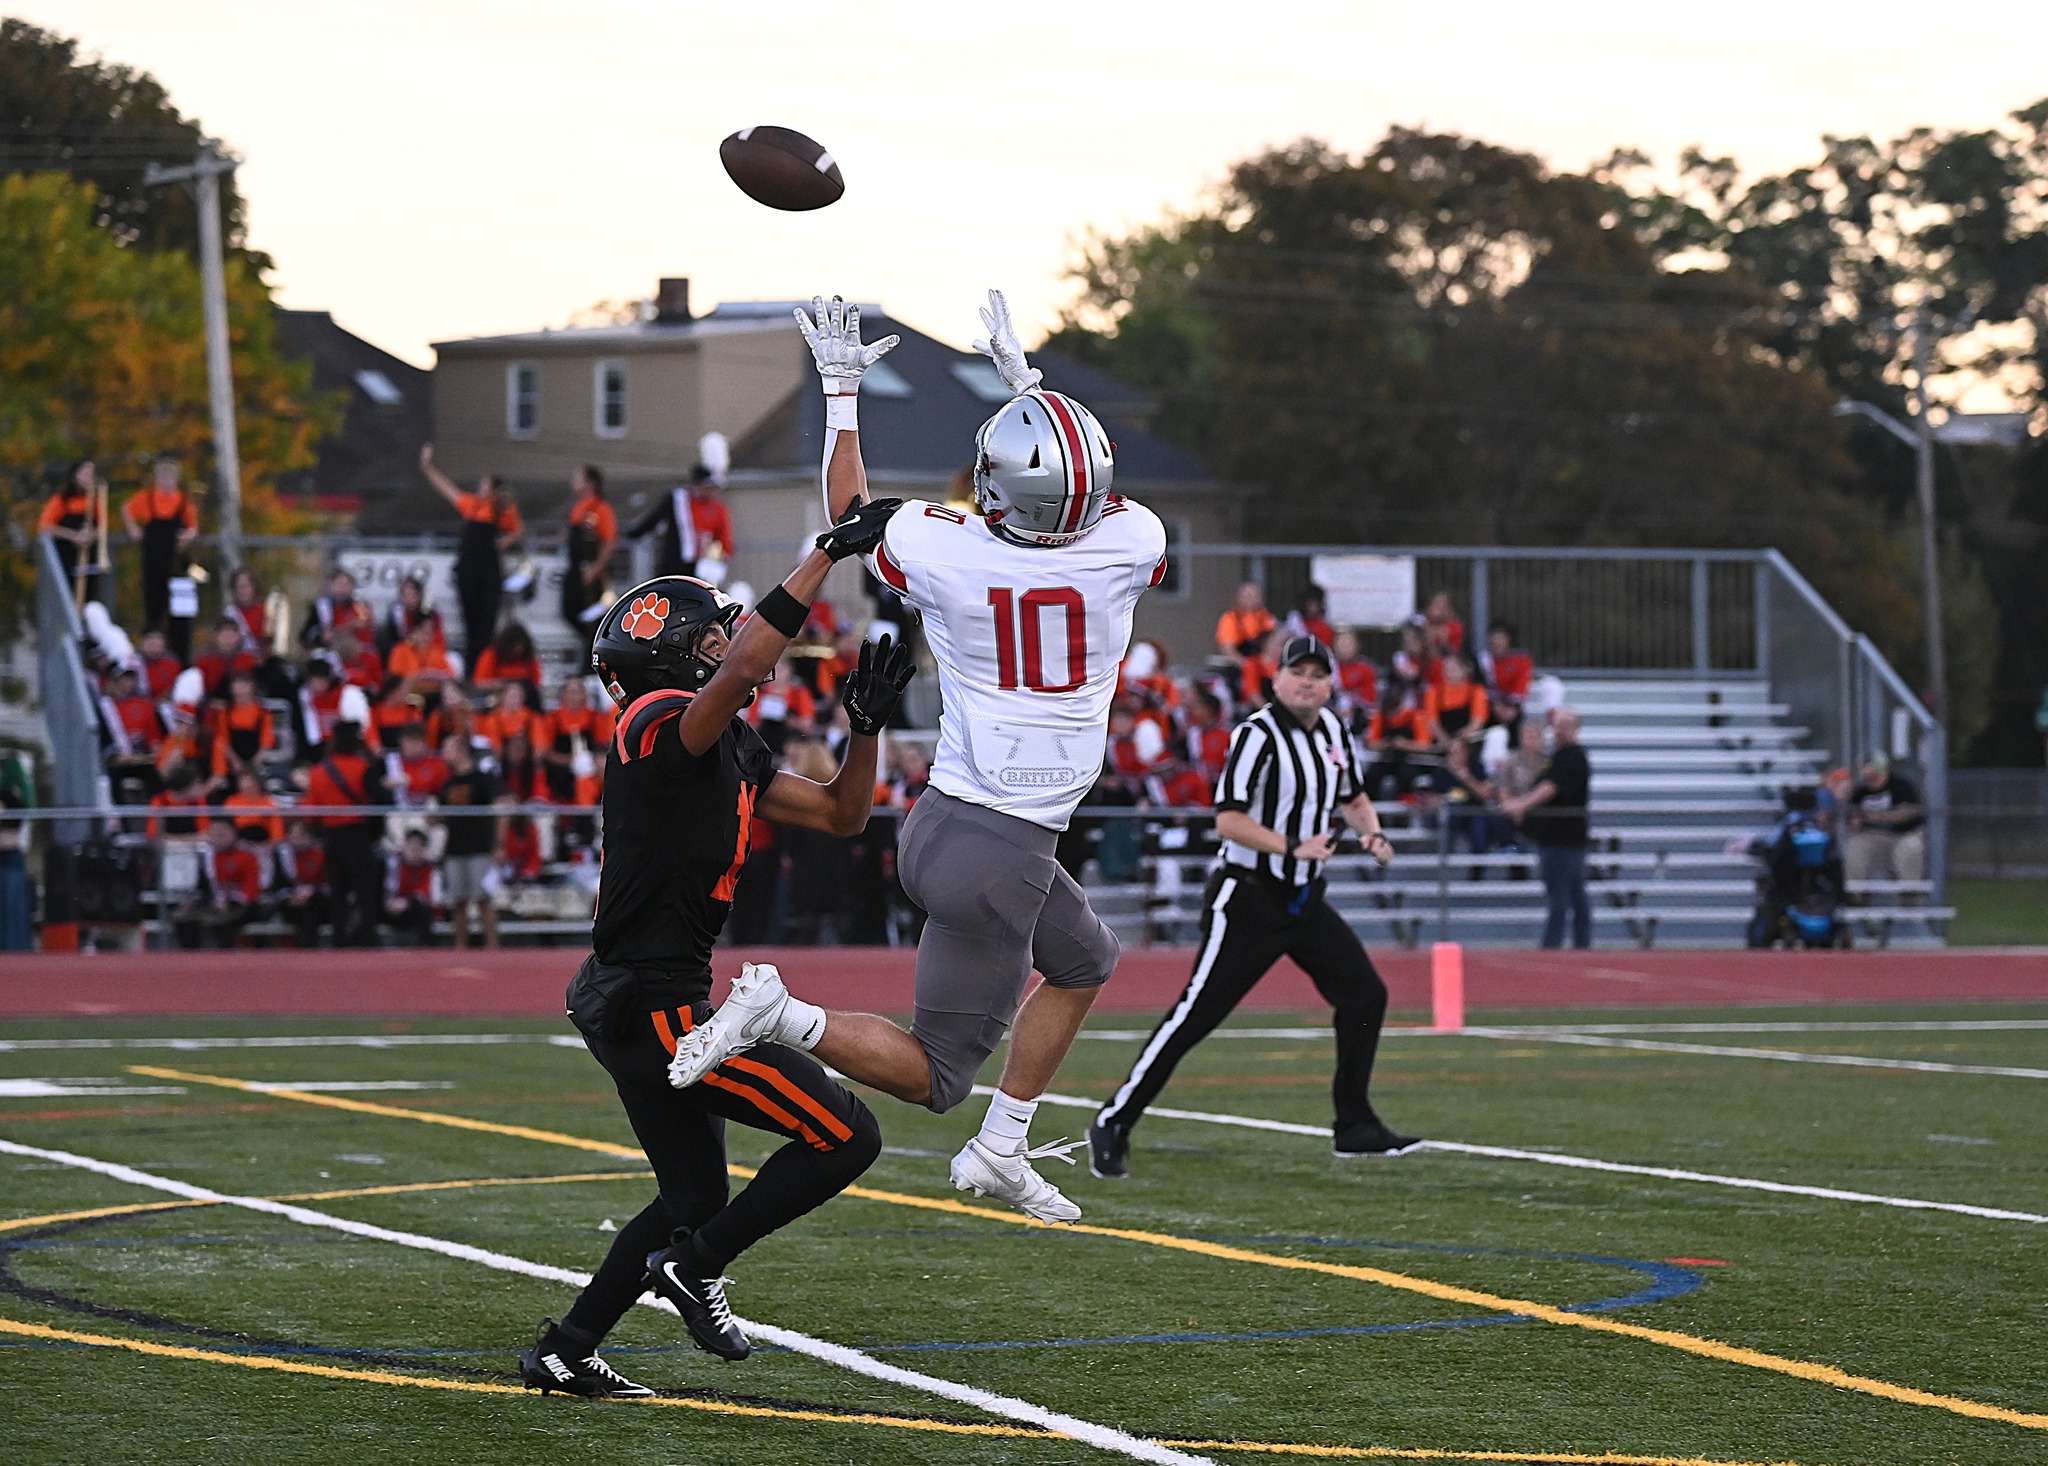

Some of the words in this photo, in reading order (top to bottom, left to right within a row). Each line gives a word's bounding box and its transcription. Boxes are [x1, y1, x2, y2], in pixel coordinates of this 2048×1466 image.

[987, 585, 1089, 694] 10
[1005, 770, 1070, 786] BATTLE
[540, 1352, 576, 1383] NIKE
